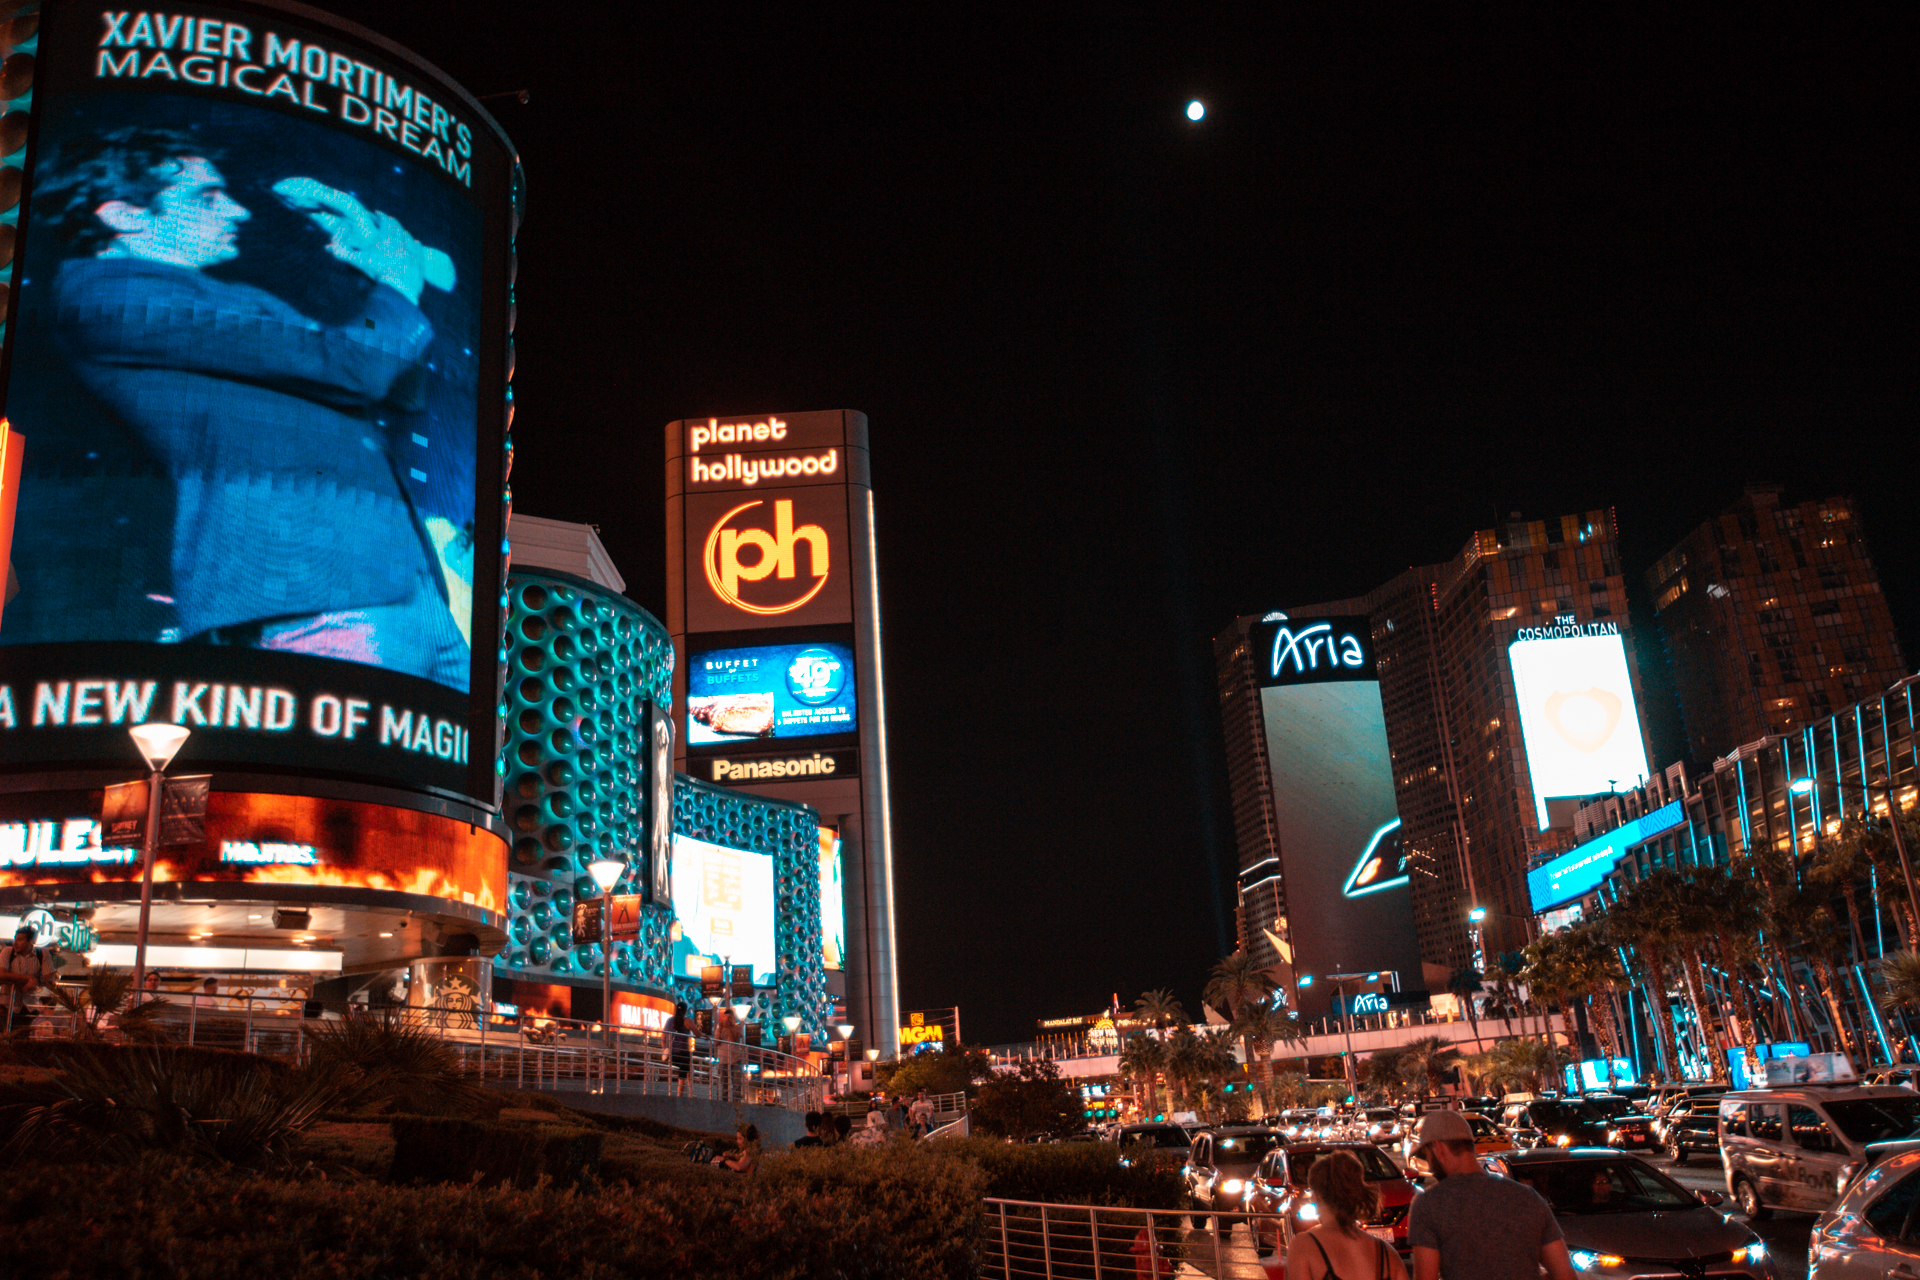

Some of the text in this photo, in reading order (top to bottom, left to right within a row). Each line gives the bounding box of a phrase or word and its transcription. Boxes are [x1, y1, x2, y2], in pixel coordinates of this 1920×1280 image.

[100, 11, 472, 159] XAVIER MORTIMER'S
[96, 50, 472, 188] MAGICAL DREAM
[691, 417, 787, 452] planet
[691, 449, 838, 485] hollywood
[719, 499, 829, 600] ph
[1554, 614, 1576, 625] THE
[1517, 621, 1618, 641] COSMOPOLITAN
[1271, 623, 1363, 677] Aria
[706, 658, 758, 670] BUFFET
[707, 673, 759, 685] BUFFETS
[0, 681, 469, 765] A NEW KIND OF MAGI
[713, 753, 835, 781] Panasonic
[1354, 992, 1389, 1013] Aria
[620, 1003, 640, 1025] MAI
[1044, 1016, 1082, 1027] MANDALAY BAY
[899, 1026, 943, 1045] MGM
[1090, 1029, 1104, 1037] NEW
